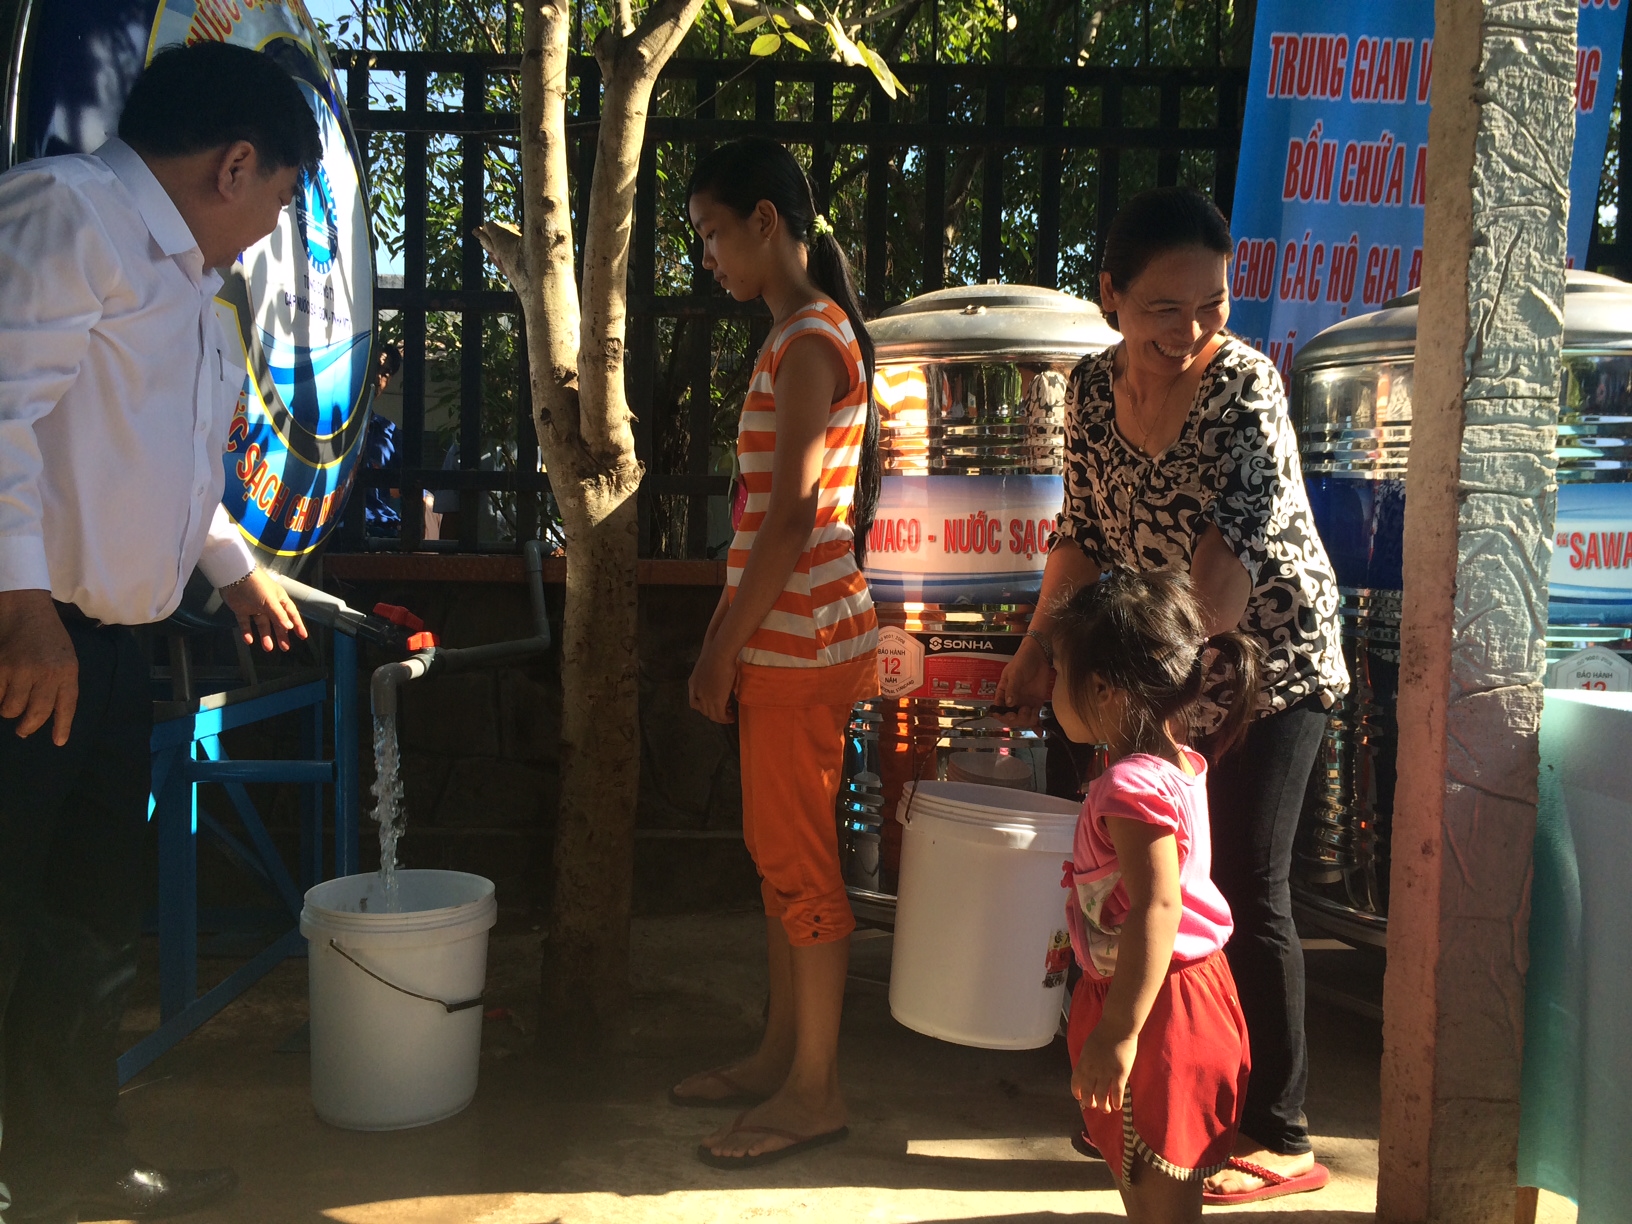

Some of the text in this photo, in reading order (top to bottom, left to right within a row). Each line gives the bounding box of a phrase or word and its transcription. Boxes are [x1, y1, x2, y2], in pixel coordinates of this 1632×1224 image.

[1268, 34, 1601, 112] TRUNG GIAN V NG
[1283, 121, 1427, 206] BỒN CHỨA N
[1232, 231, 1423, 316] CHO CÁC HỘ GIA Đ
[236, 443, 290, 523] SẠCH
[284, 493, 320, 532] CHO
[867, 518, 921, 552] WACO
[943, 510, 1002, 554] NƯỚC
[1556, 531, 1632, 570] “SAWA
[882, 657, 901, 675] 12
[943, 639, 993, 650] SONHA
